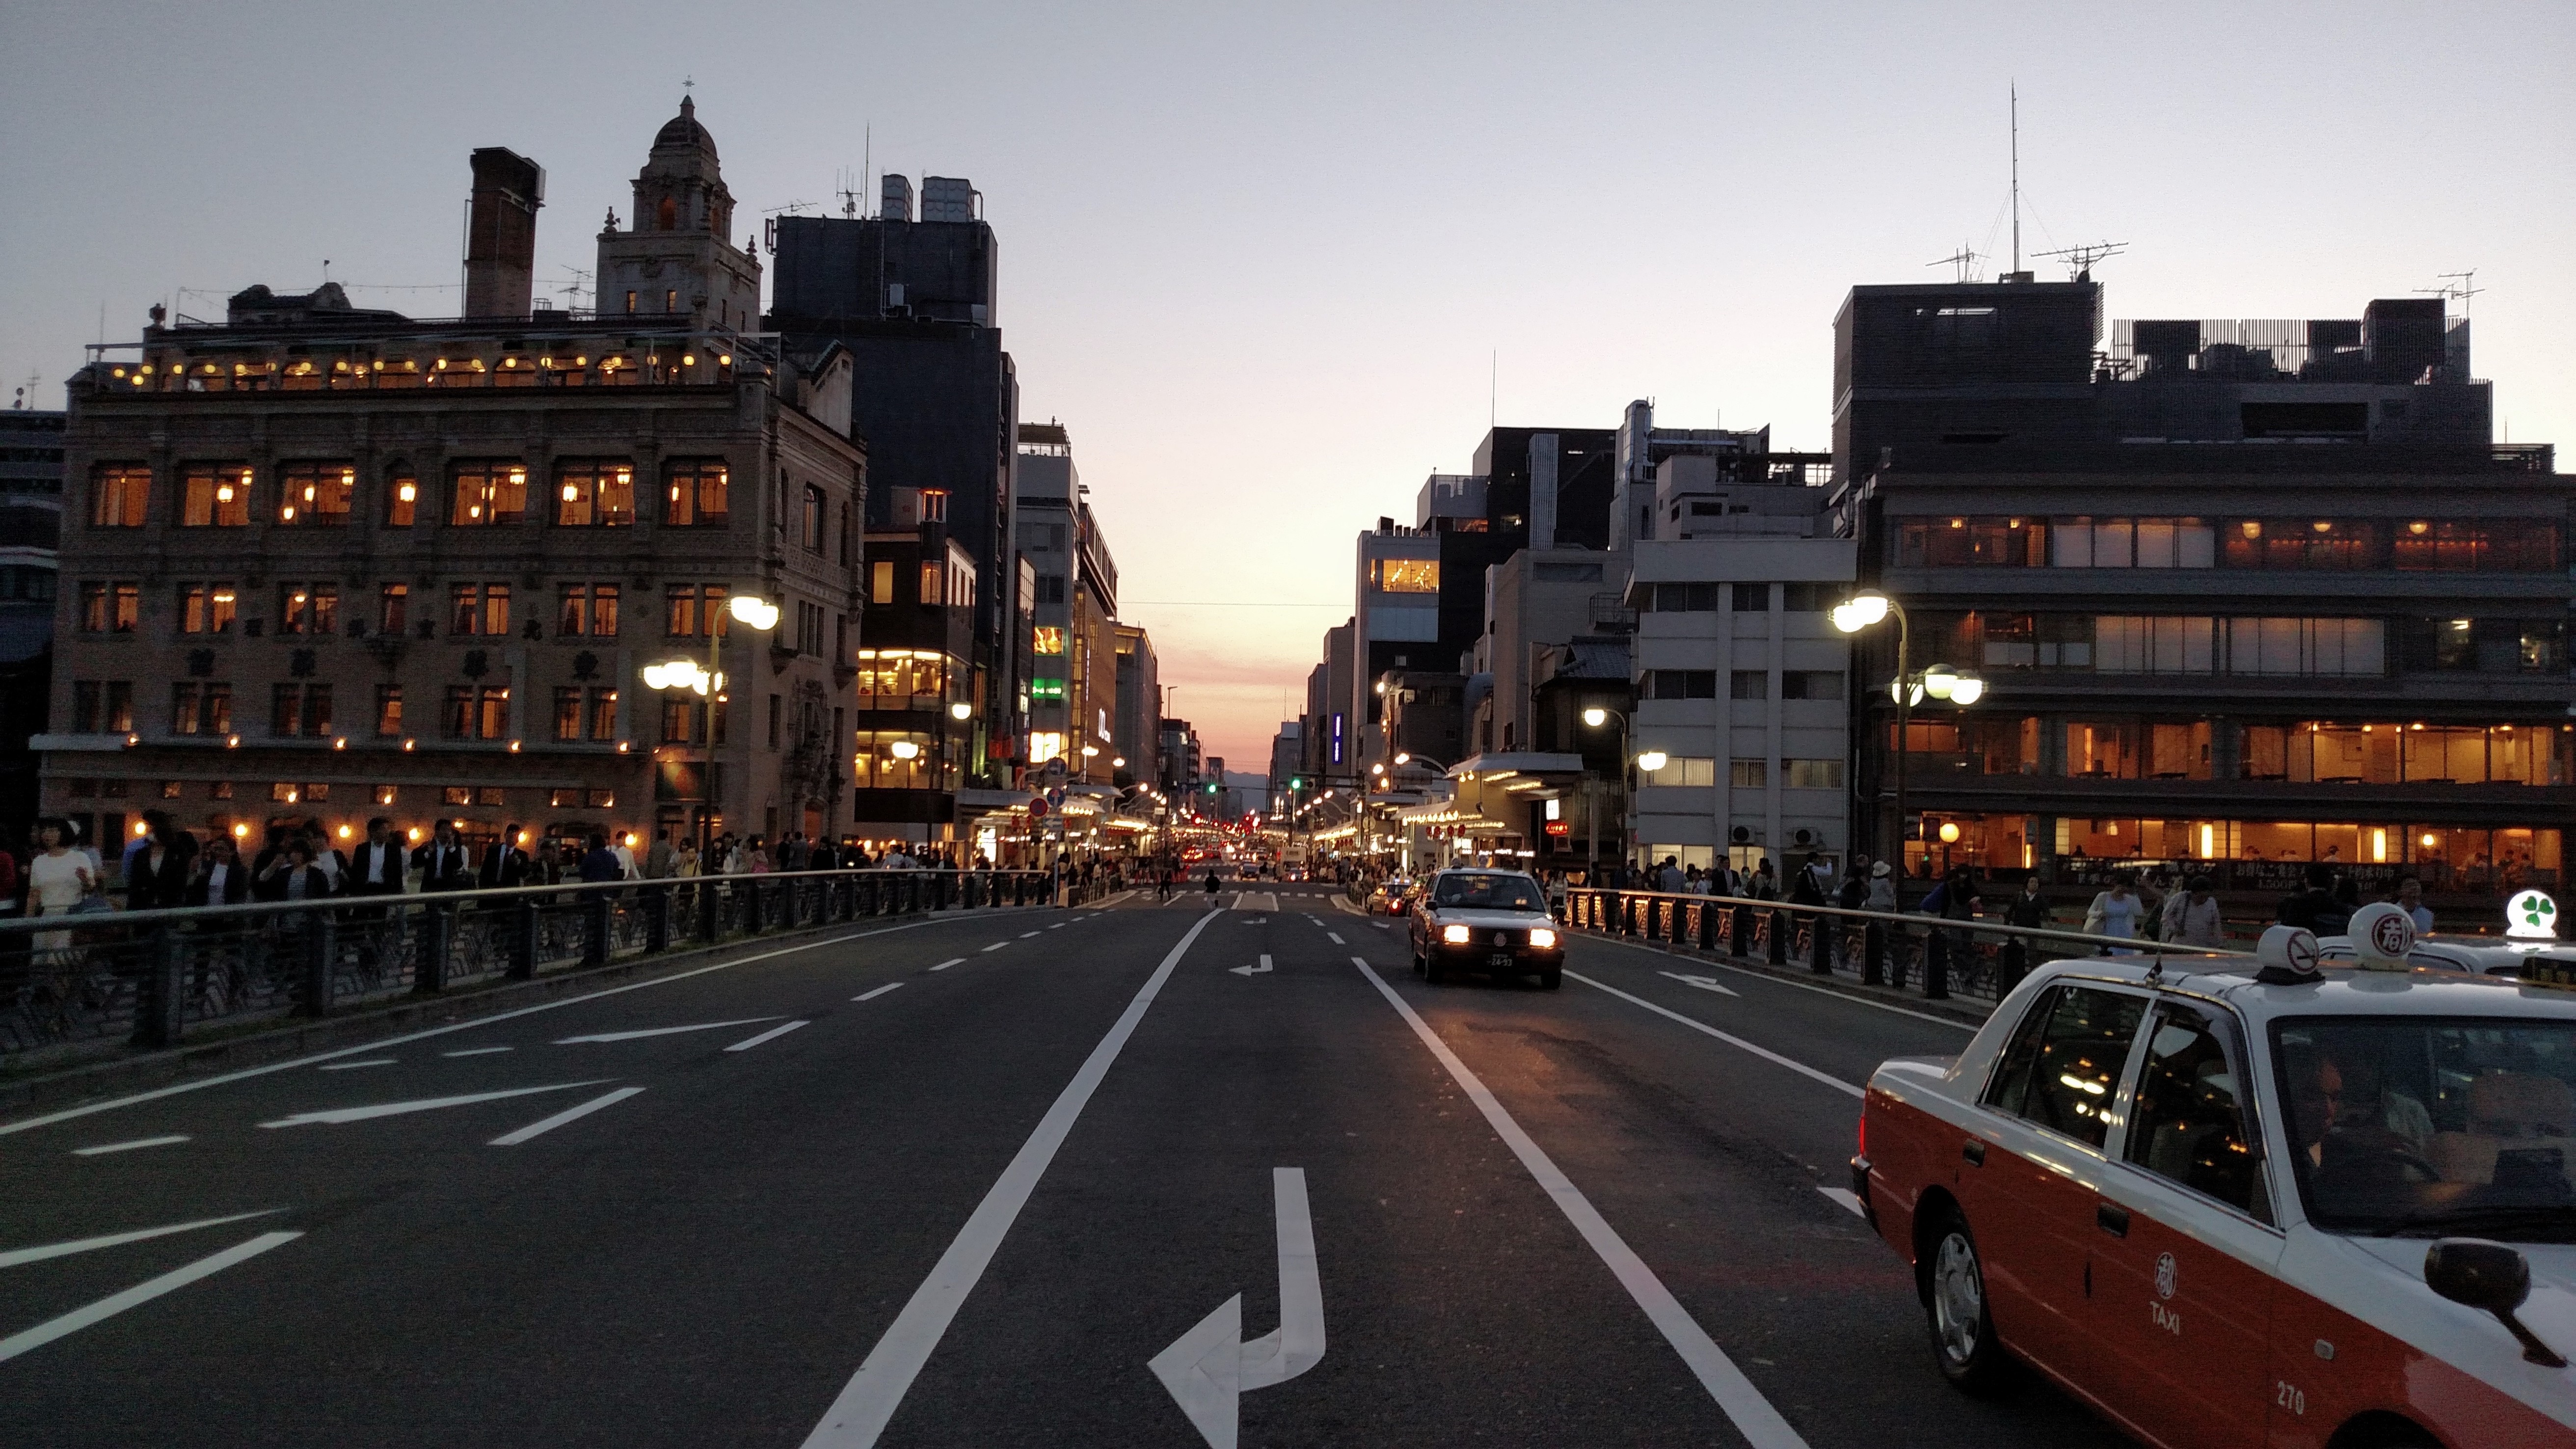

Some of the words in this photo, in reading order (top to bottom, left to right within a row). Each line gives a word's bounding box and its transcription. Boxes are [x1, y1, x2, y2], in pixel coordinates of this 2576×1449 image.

[2380, 916, 2412, 953] 都
[2157, 1253, 2176, 1296] 都
[2149, 1301, 2179, 1335] TAXI
[2278, 1380, 2304, 1415] 270
